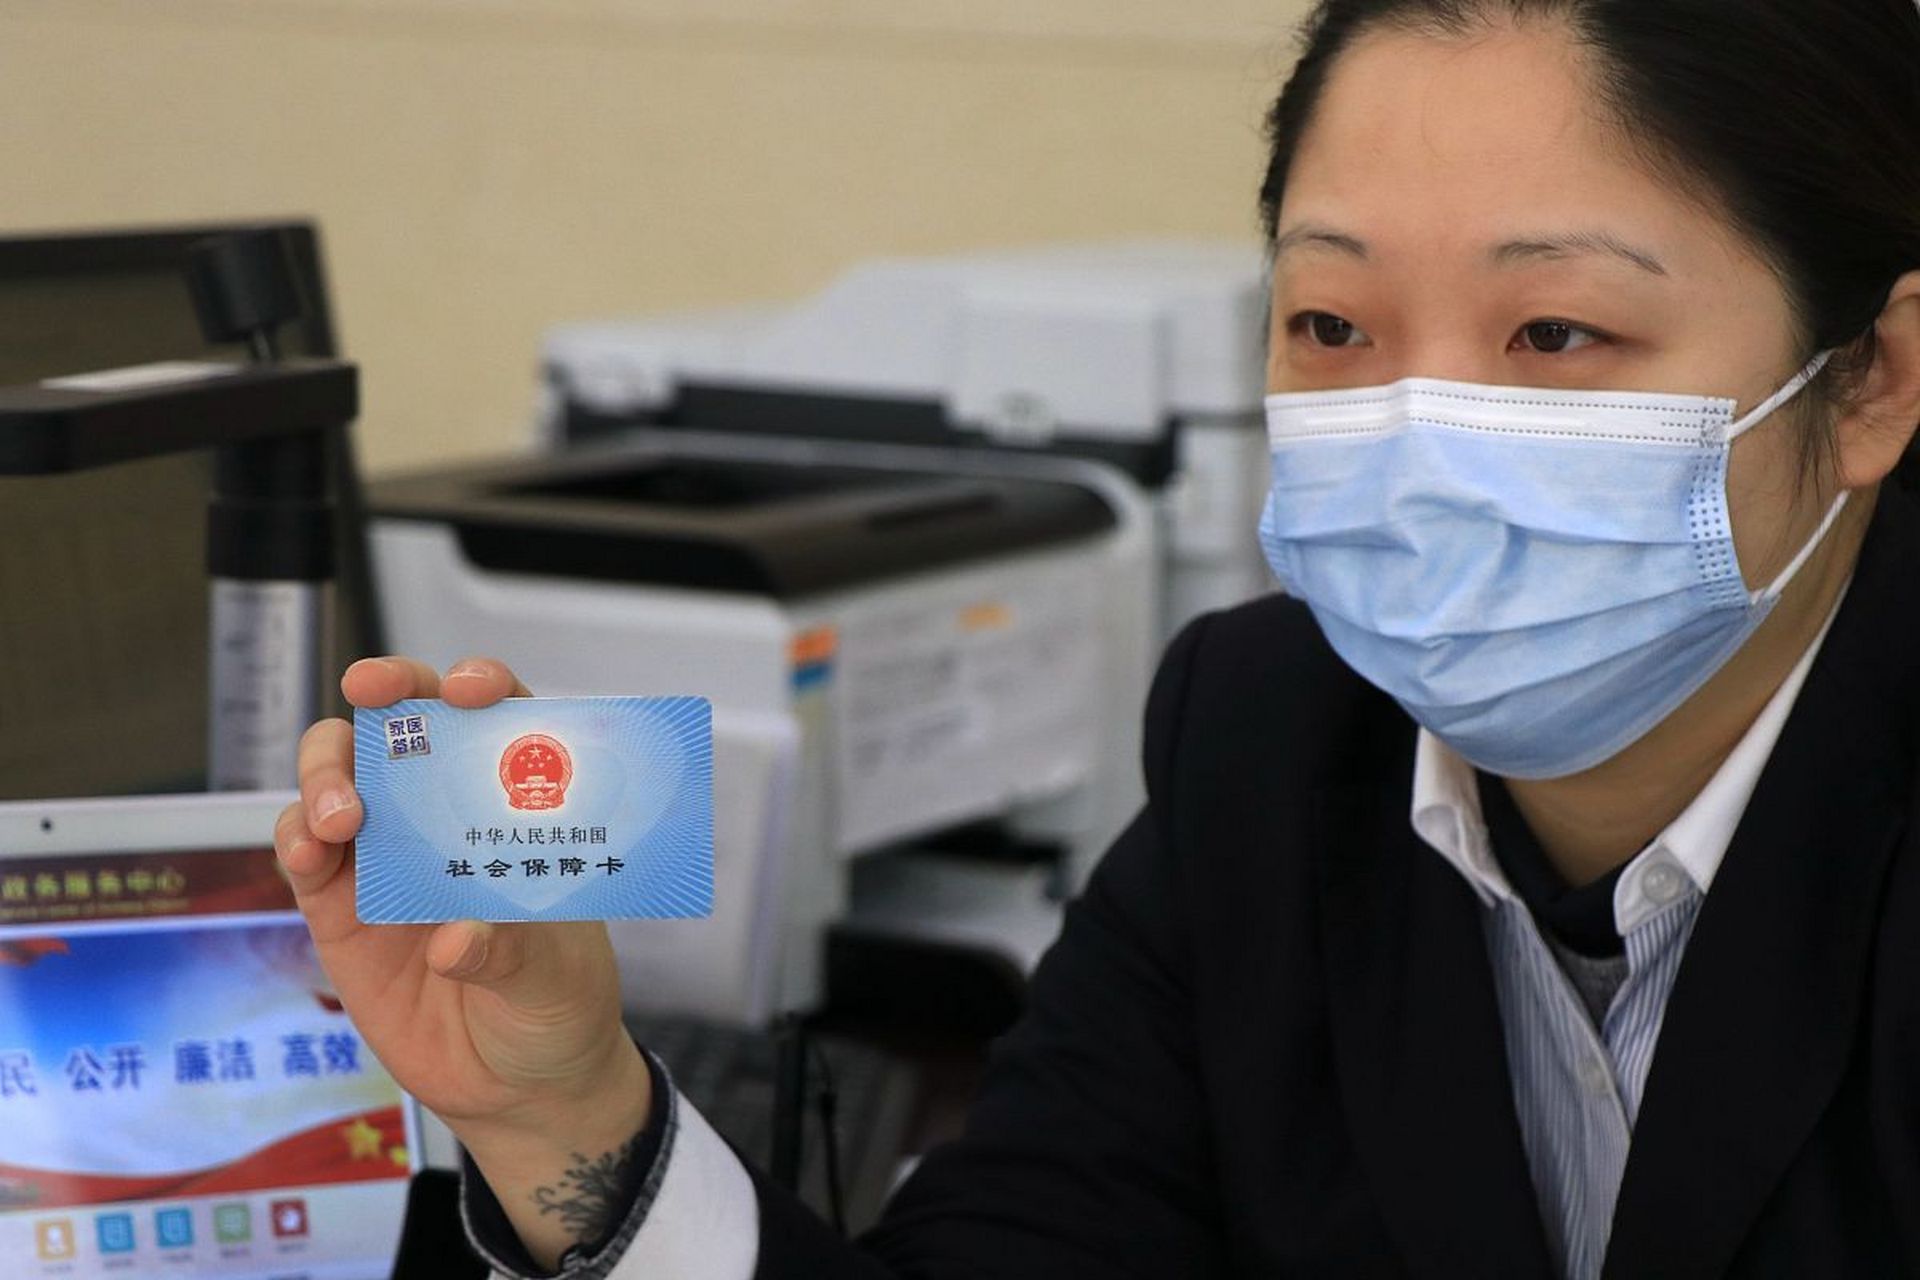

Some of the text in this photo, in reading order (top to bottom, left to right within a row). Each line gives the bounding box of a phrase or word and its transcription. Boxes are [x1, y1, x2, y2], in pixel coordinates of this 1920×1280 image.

[389, 716, 423, 736] 家医
[392, 736, 426, 754] 签约
[466, 826, 607, 846] 中华人民共和国
[446, 856, 625, 878] 社会保障卡
[66, 1045, 146, 1091] 公开
[173, 1038, 256, 1082] 廉洁
[283, 1032, 362, 1077] 高效
